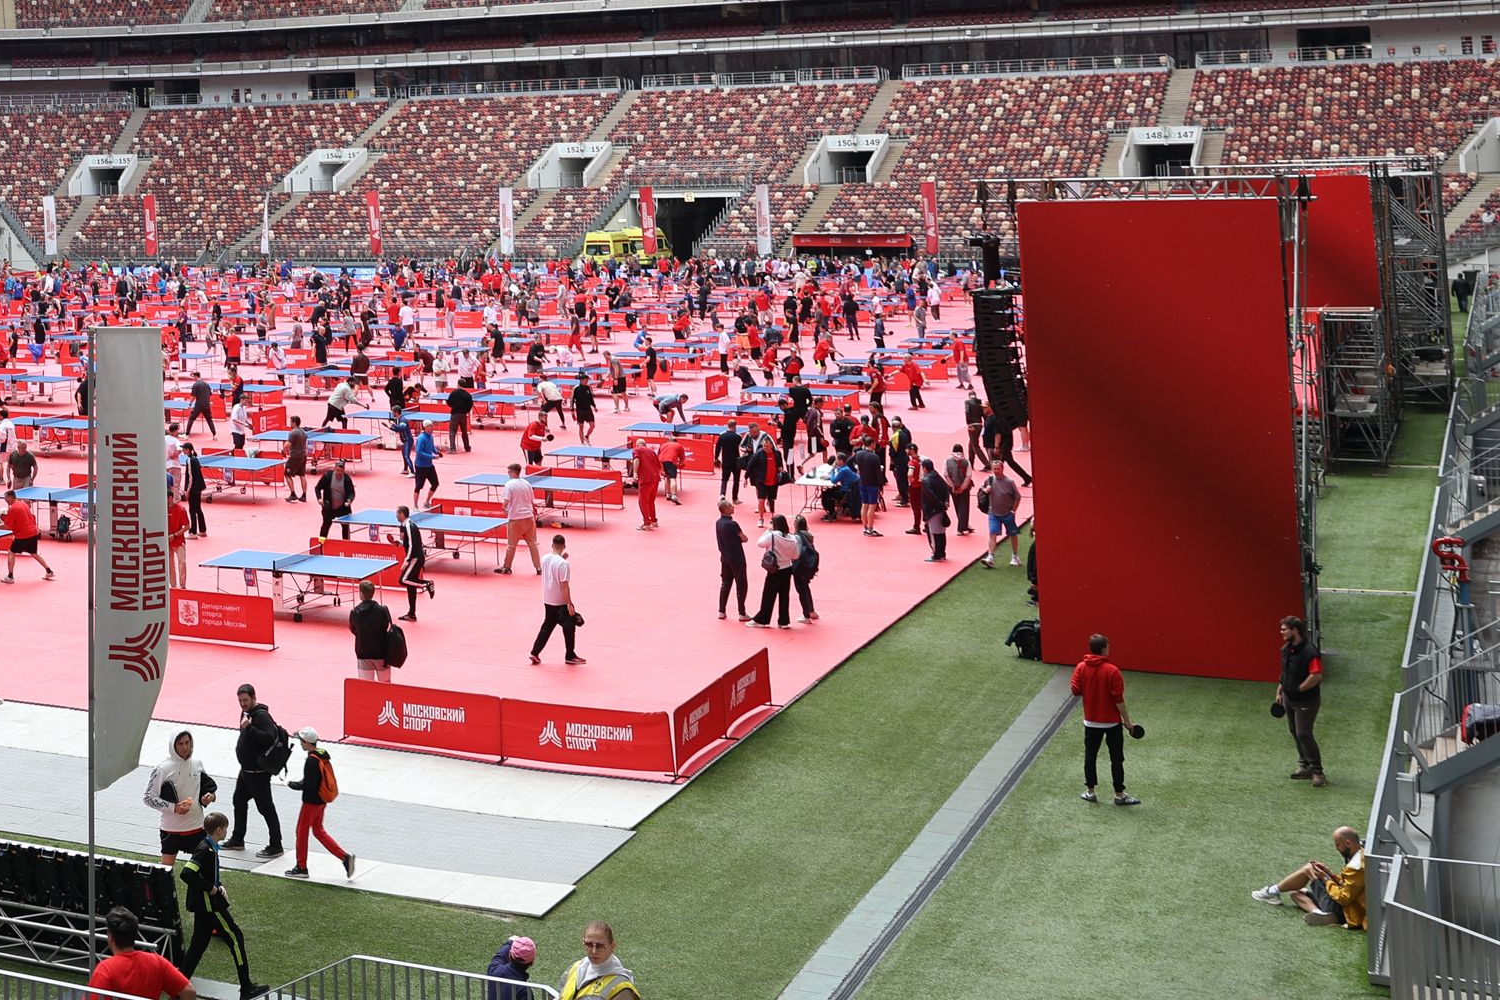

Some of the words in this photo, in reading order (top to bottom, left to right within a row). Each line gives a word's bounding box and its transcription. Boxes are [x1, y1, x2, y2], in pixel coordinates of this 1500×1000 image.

[1146, 131, 1163, 139] 148
[1177, 130, 1195, 138] 147
[97, 157, 109, 165] 156
[105, 433, 140, 611] МОСКОВСКИЙ
[142, 528, 166, 611] СПОРТ
[201, 602, 241, 612] Департамент
[201, 611, 223, 619] спорта
[202, 619, 223, 627] города
[224, 620, 247, 629] Москвы
[402, 702, 466, 724] МОСКОВСКИЙ
[402, 717, 433, 733] СПОРТ
[566, 722, 634, 742] МОСКОВСКИЙ
[566, 736, 597, 752] СПОРТ
